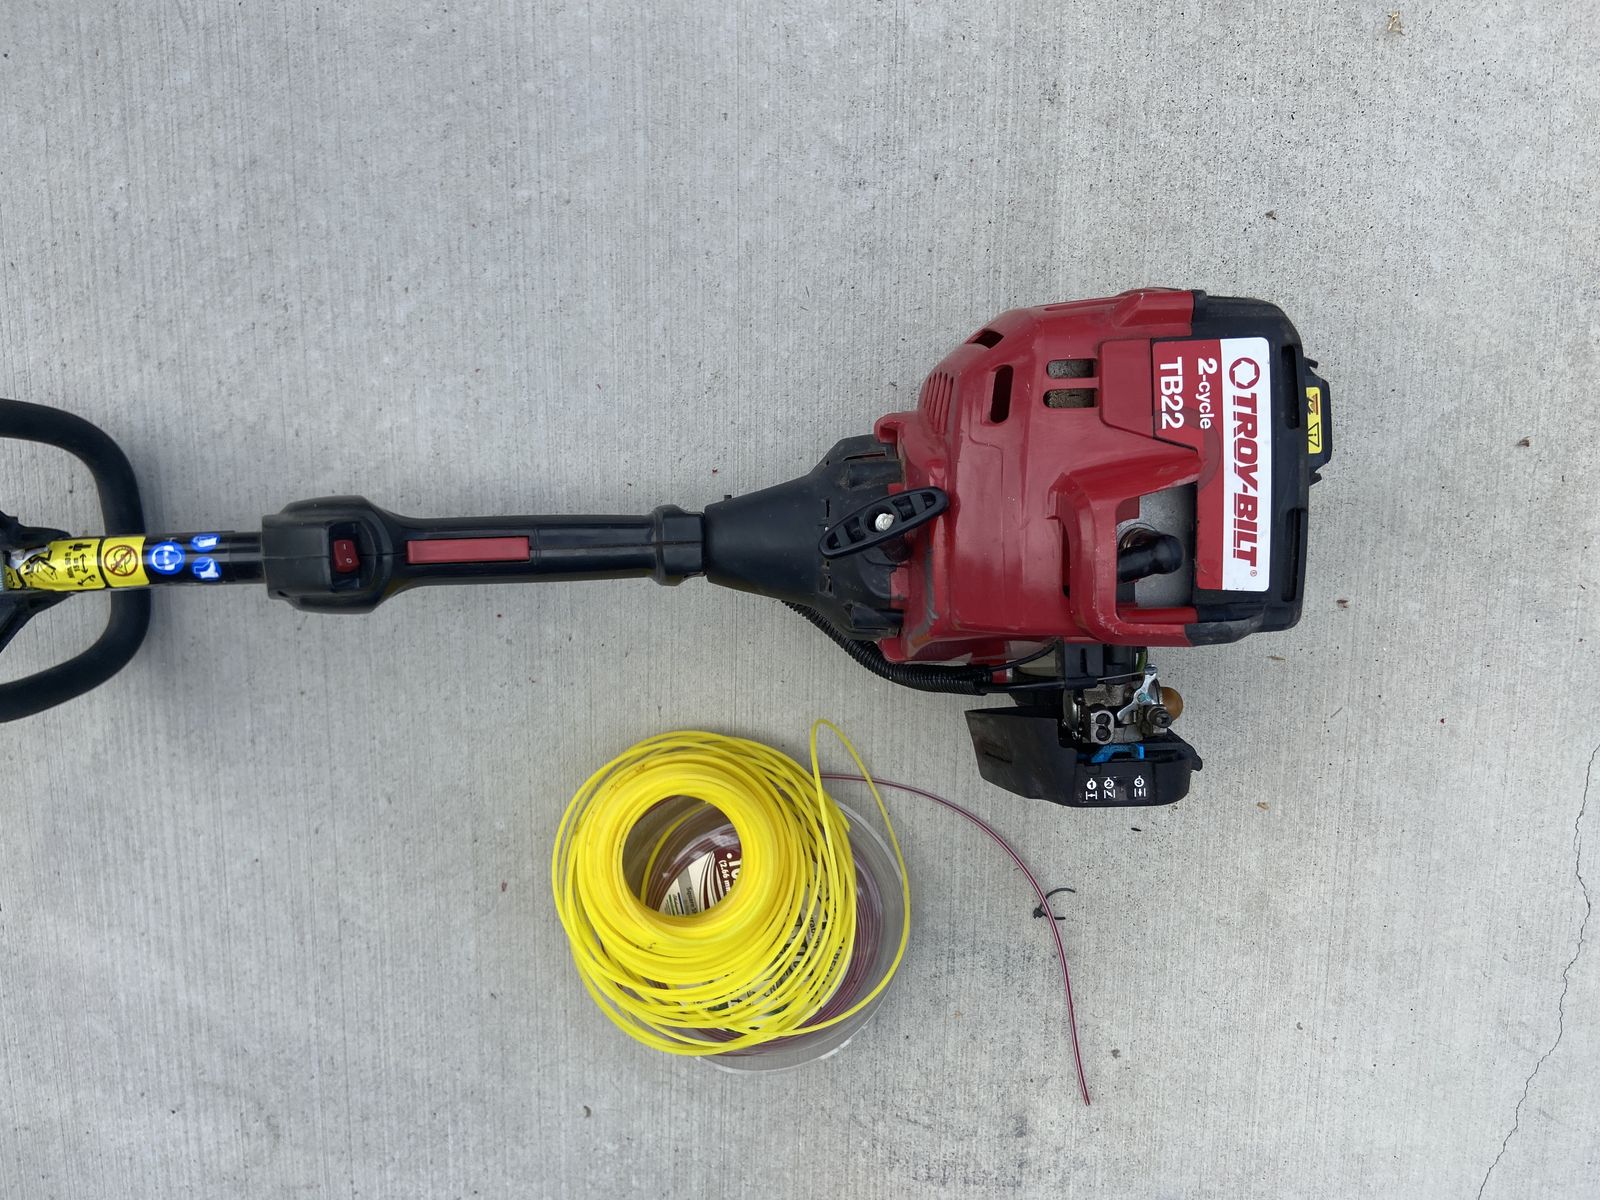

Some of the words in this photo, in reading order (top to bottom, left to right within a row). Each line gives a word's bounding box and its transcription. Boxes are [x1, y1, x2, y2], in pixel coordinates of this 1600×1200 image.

[1160, 356, 1184, 430] TB22
[1195, 357, 1217, 429] 2-cycle
[1232, 392, 1258, 567] TROY-BILT
[726, 852, 742, 884] .10
